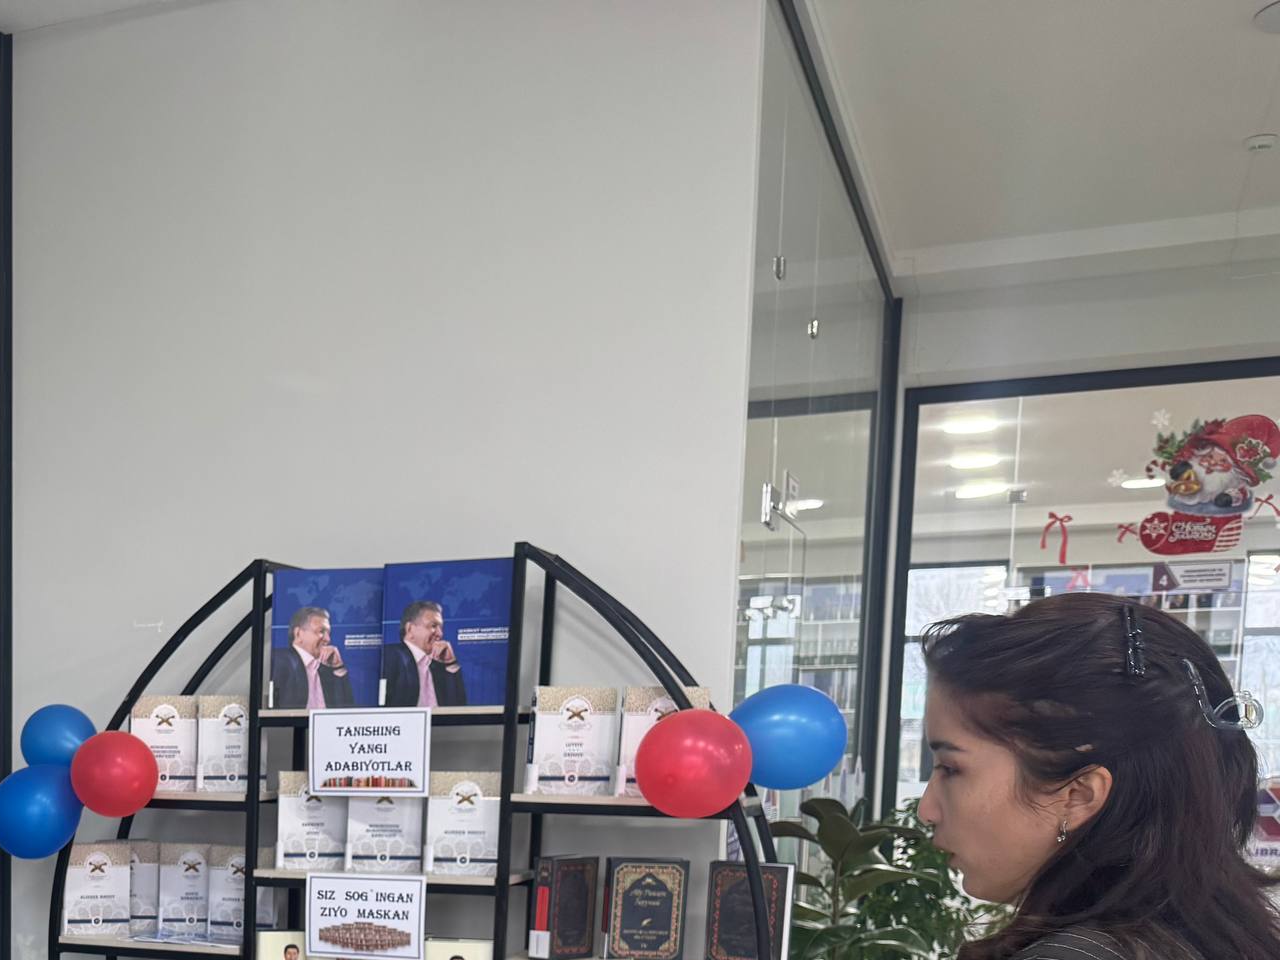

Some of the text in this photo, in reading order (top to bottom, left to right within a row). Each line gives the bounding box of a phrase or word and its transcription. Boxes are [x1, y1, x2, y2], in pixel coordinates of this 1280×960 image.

[336, 725, 401, 737] TANISHING
[349, 742, 387, 754] YANGI
[325, 760, 412, 771] ADABIYOTLAR
[317, 889, 336, 901] SIZ
[320, 905, 410, 921] ZIYO MASKAN
